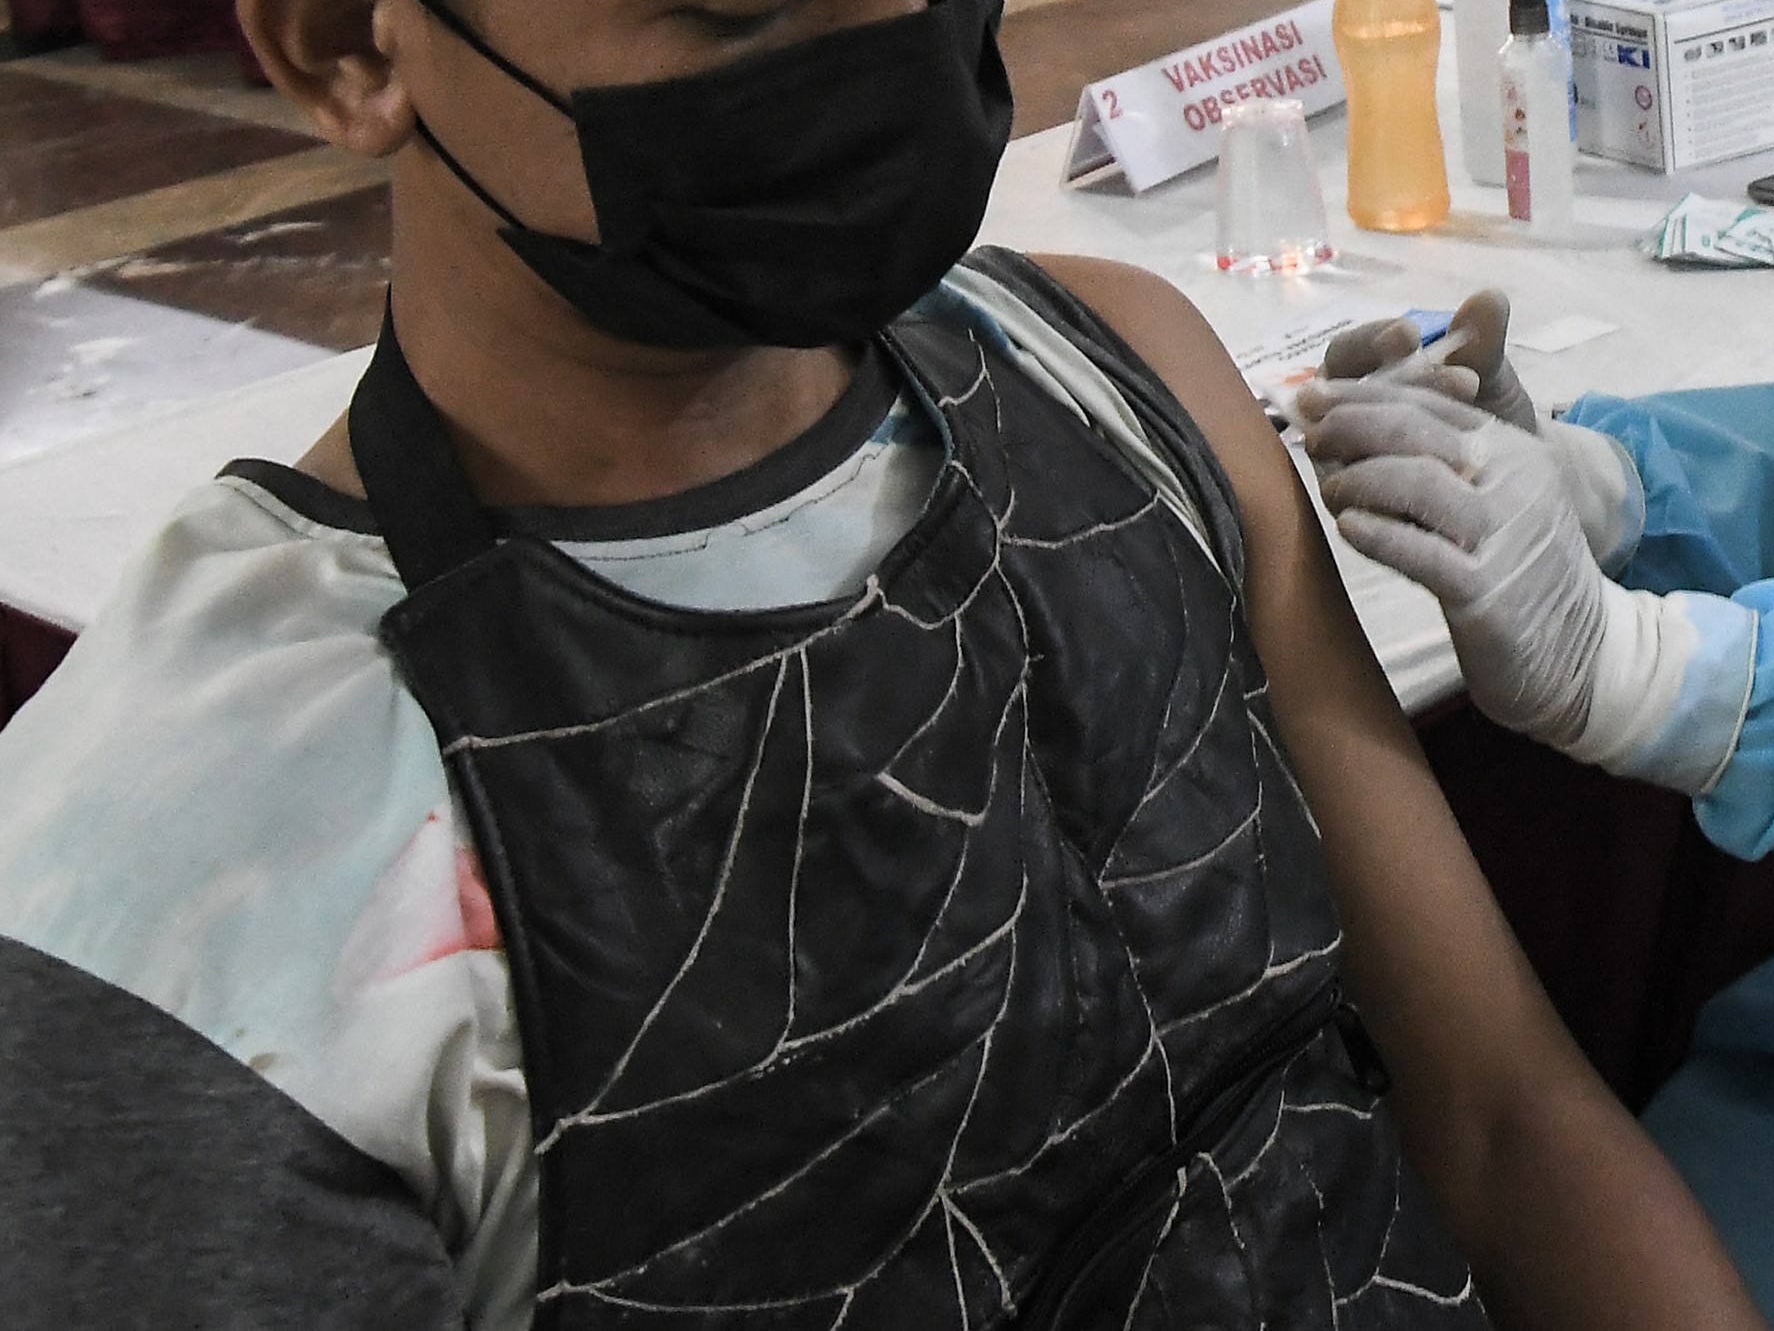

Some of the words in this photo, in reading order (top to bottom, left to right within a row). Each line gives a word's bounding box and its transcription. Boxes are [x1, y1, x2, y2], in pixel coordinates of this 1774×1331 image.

[1161, 20, 1303, 93] VAKSINASI
[1183, 54, 1328, 131] OBSERVASI
[1102, 89, 1122, 119] 2
